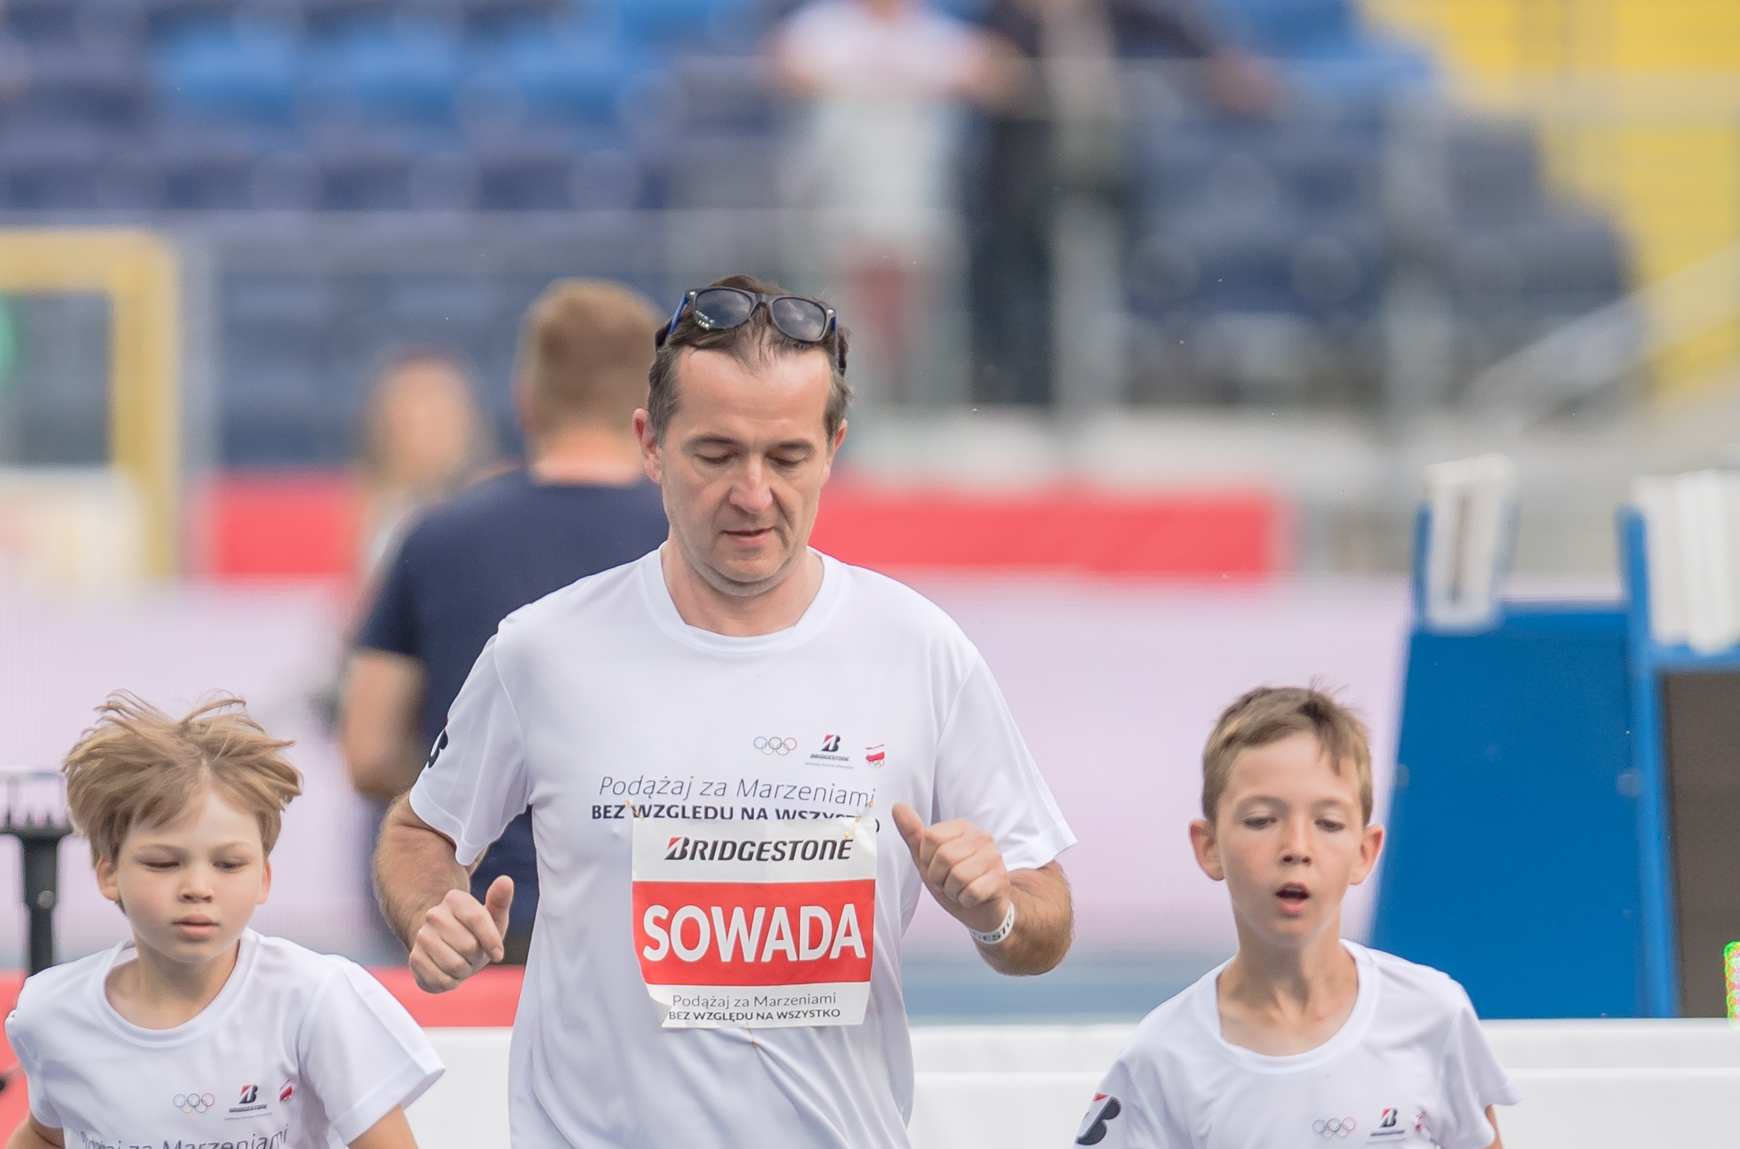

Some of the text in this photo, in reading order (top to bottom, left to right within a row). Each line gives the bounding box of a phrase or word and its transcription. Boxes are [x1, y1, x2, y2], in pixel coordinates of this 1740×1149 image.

[599, 775, 876, 808] Podążaj za Marzeniami
[592, 804, 625, 820] BEZ
[741, 807, 768, 820] NA
[664, 837, 853, 861] BRIDGESTONE
[643, 903, 866, 962] SOWADA
[673, 992, 837, 1009] Podążaj za Marzeniami
[669, 1008, 841, 1022] BEZ WZGLĘDU NA WSZYSTKO
